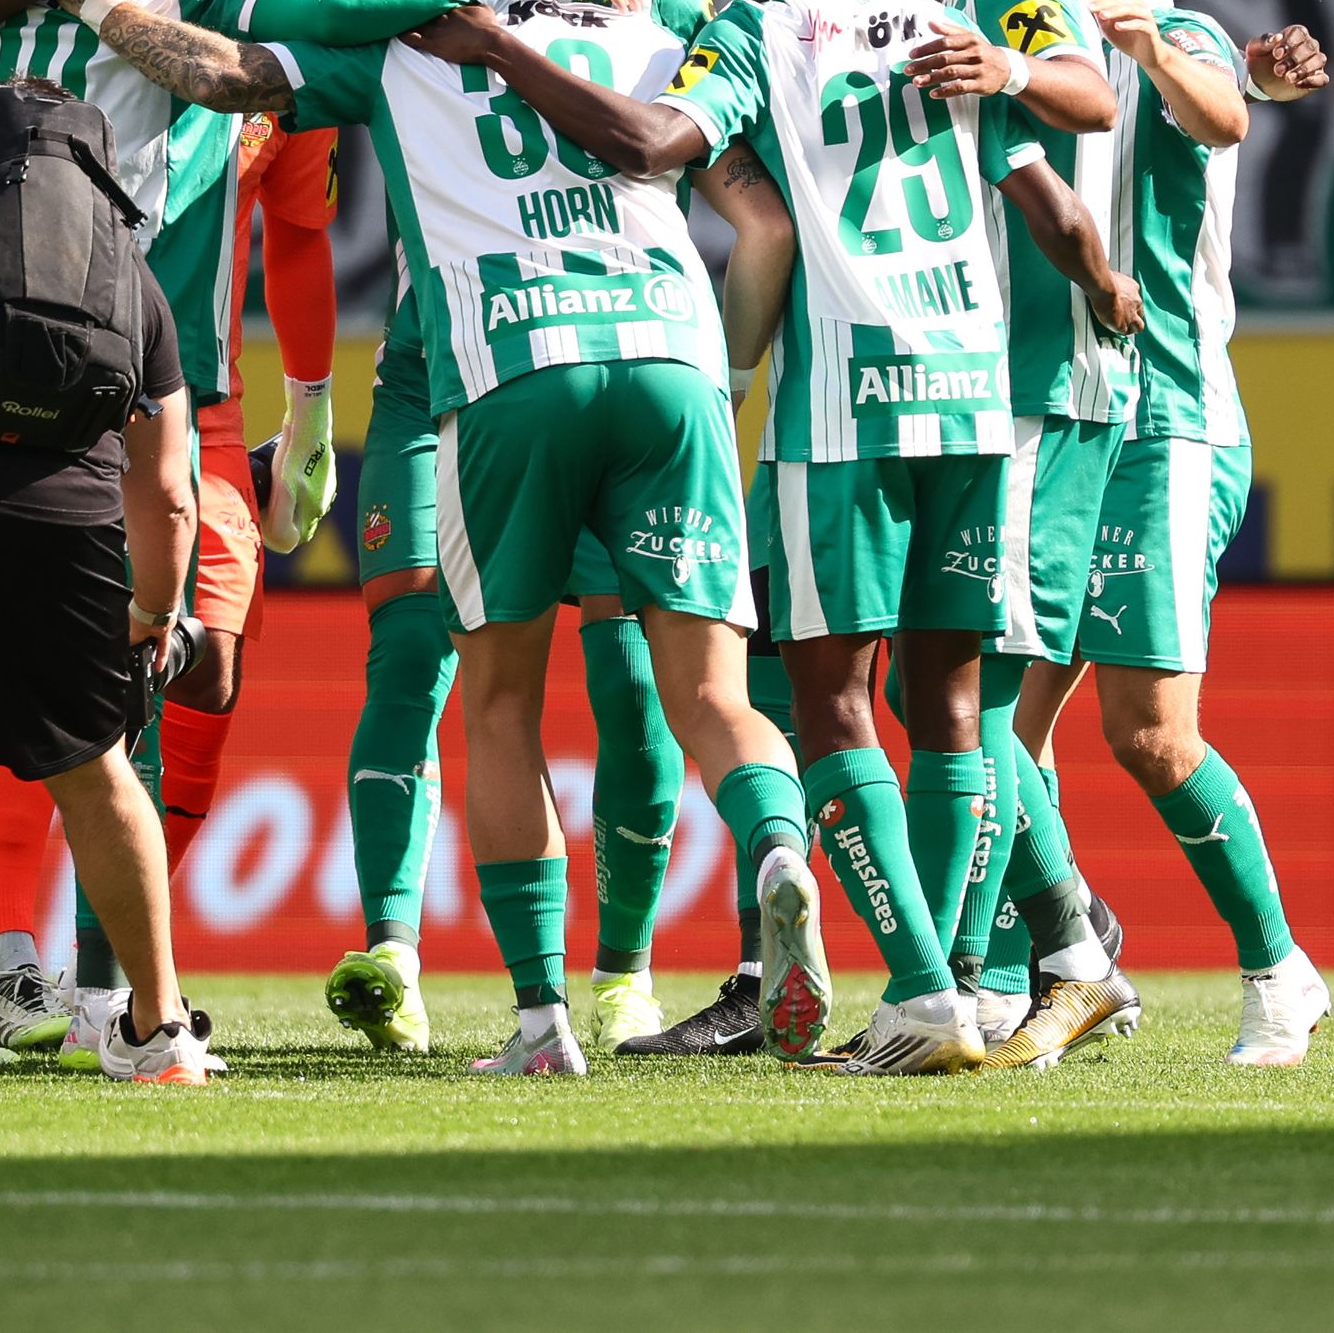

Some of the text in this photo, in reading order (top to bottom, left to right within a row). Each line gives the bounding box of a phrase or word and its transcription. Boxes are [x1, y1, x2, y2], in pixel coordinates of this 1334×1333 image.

[821, 61, 974, 256] 29
[517, 183, 620, 239] HORN
[487, 283, 637, 332] Allianz
[856, 363, 992, 405] Allianz
[1, 401, 60, 420] Rollei
[834, 825, 897, 935] easystaff
